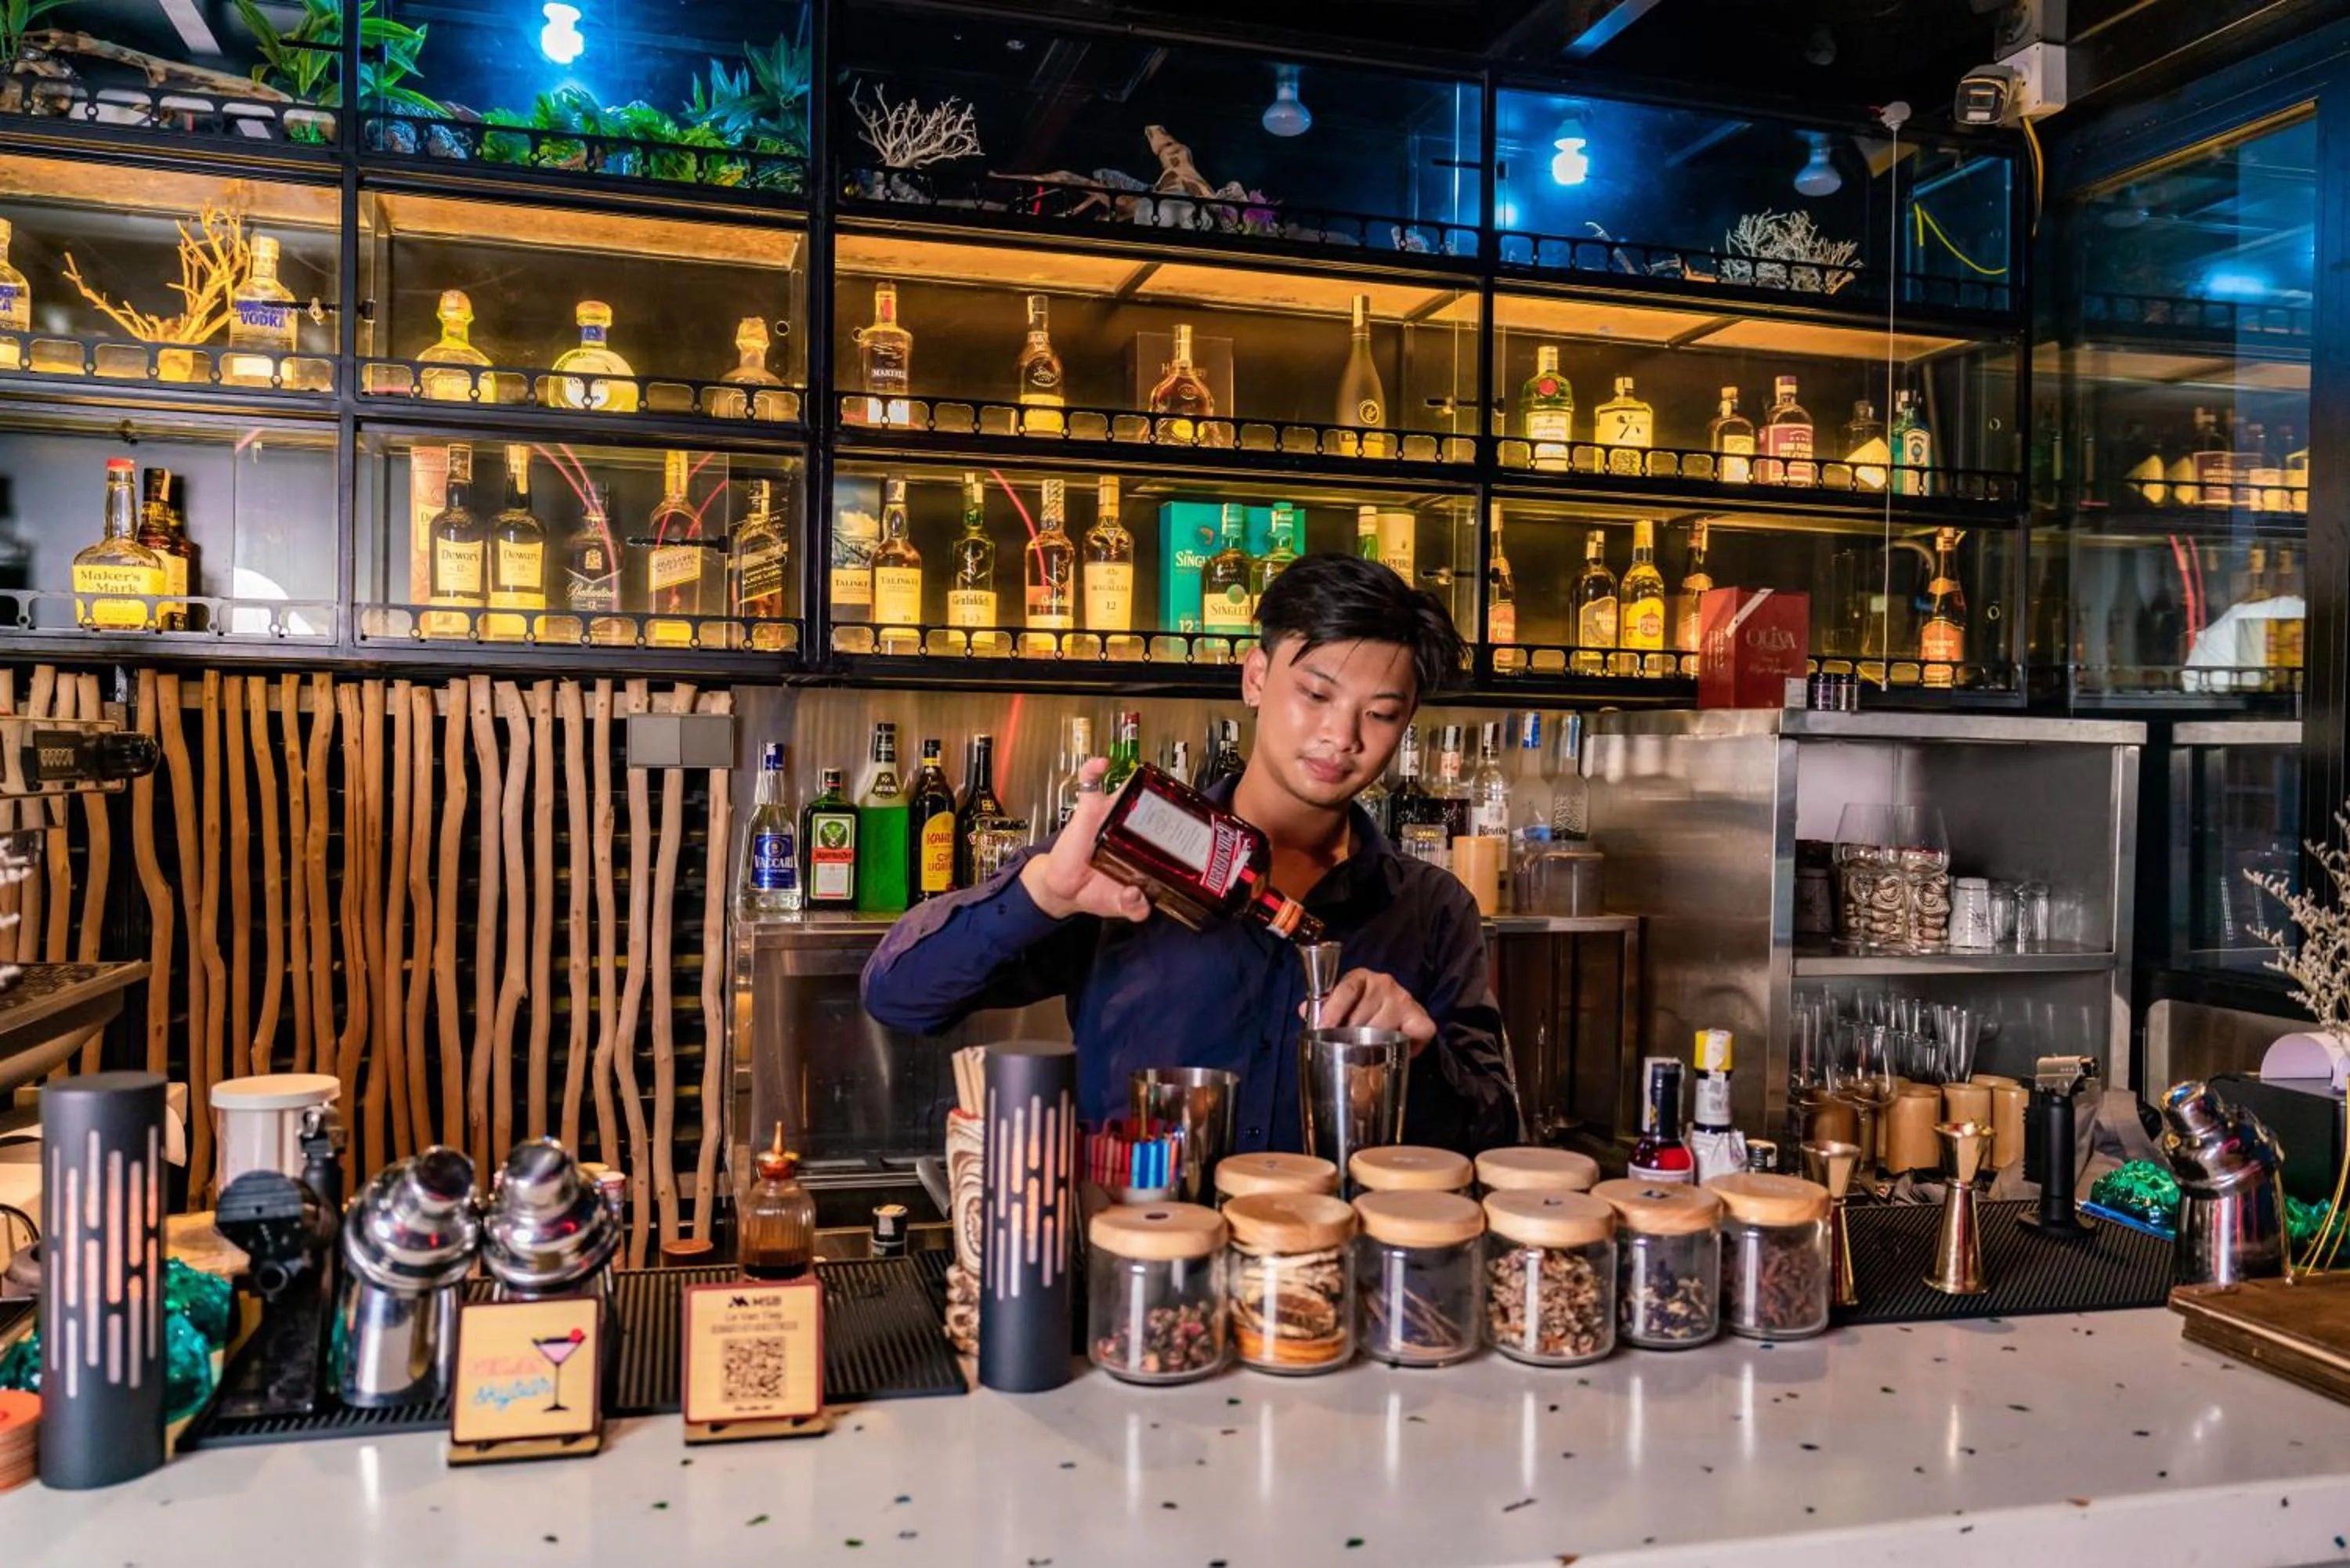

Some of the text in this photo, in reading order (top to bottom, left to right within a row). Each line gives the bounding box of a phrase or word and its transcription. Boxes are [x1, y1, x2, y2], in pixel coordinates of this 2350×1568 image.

[80, 569, 142, 582] Maker's
[96, 582, 139, 594] Mark
[1105, 601, 1117, 610] 12
